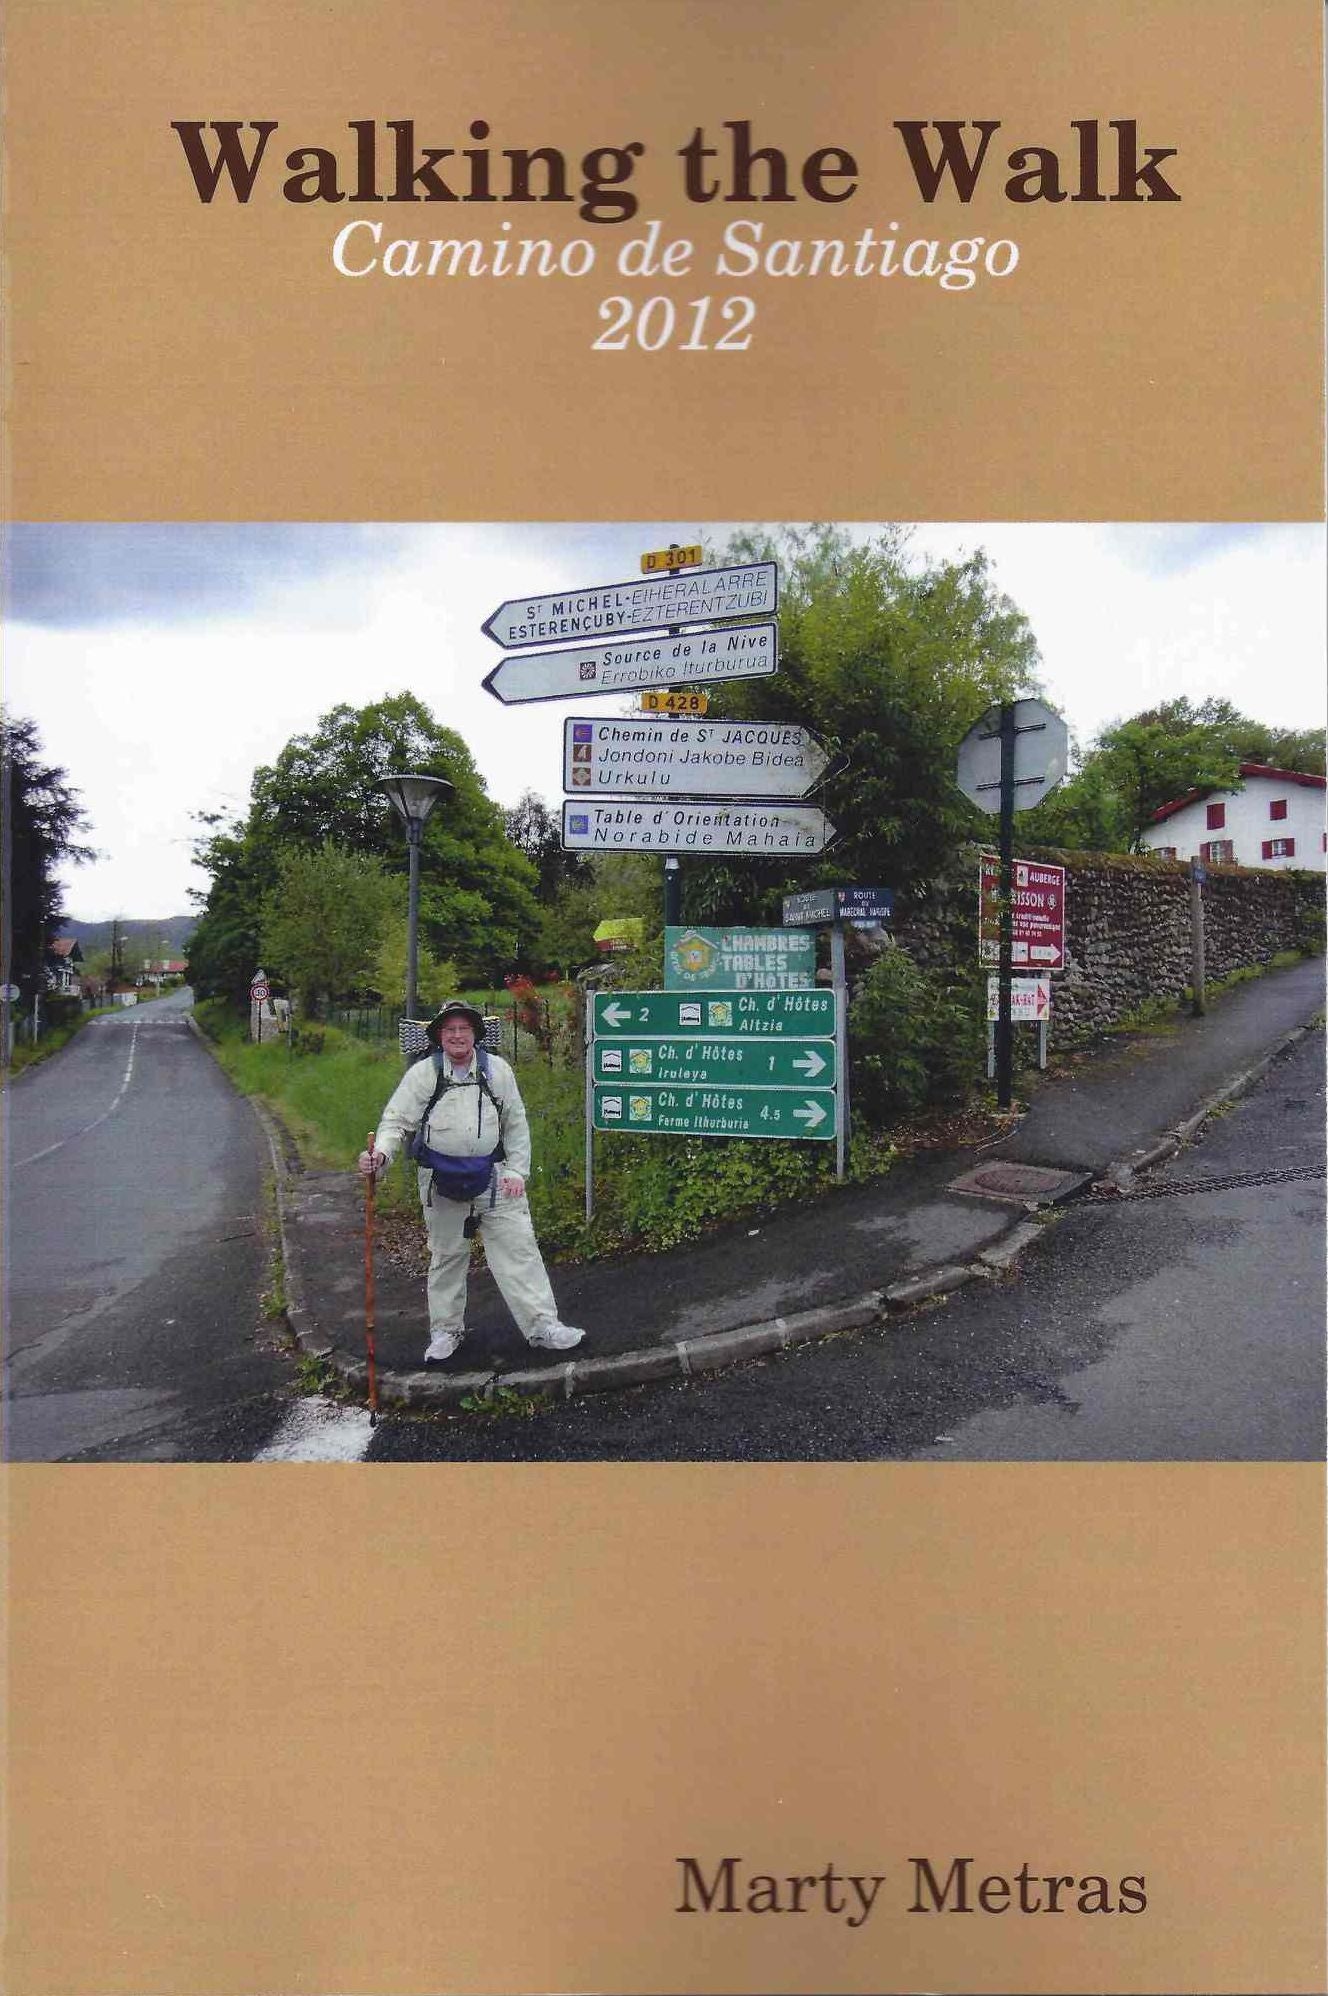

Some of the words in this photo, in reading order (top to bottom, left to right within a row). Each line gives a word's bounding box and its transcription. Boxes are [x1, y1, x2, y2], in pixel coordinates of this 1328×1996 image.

[171, 120, 645, 222] Walking
[678, 120, 858, 203] the
[893, 120, 1181, 203] Walk
[333, 221, 594, 276] Camino
[619, 222, 690, 275] de
[719, 221, 1018, 289] Santiago
[594, 297, 754, 350] 2012
[646, 554, 656, 568] D
[666, 549, 696, 565] 301
[603, 650, 662, 666] Source
[672, 643, 692, 657] de
[702, 638, 716, 653] la
[728, 634, 768, 650] Nive
[602, 666, 676, 686] Errobiko
[684, 654, 768, 676] Iturburua
[649, 694, 658, 708] D
[665, 695, 700, 710] 428
[598, 727, 663, 742] Chemin
[670, 729, 689, 743] de
[722, 730, 802, 746] JACQUES
[598, 750, 674, 764] Jondoni
[680, 750, 746, 766] Jakobe
[752, 752, 804, 767] Bidea
[598, 770, 671, 786] Urkulu
[594, 809, 642, 824] Table
[674, 812, 780, 828] Orientation
[594, 828, 712, 846] Norabide
[726, 832, 815, 848] Mahaia
[1030, 871, 1061, 886] AUBERGE
[722, 934, 811, 952] CHAMBRES
[722, 954, 788, 972] TABLES
[638, 1008, 648, 1022] 2
[738, 997, 759, 1012] Ch.
[785, 997, 828, 1012] Hôtes
[738, 1019, 783, 1032] Altzia
[658, 1046, 679, 1060] Ch.
[702, 1046, 743, 1062] Hôtes
[768, 1056, 775, 1071] 1
[658, 1092, 679, 1108] Ch.
[702, 1094, 743, 1110] Hôtes
[658, 1115, 690, 1127] Ferme
[675, 1858, 886, 1927] Marty
[907, 1858, 1146, 1914] Metras
